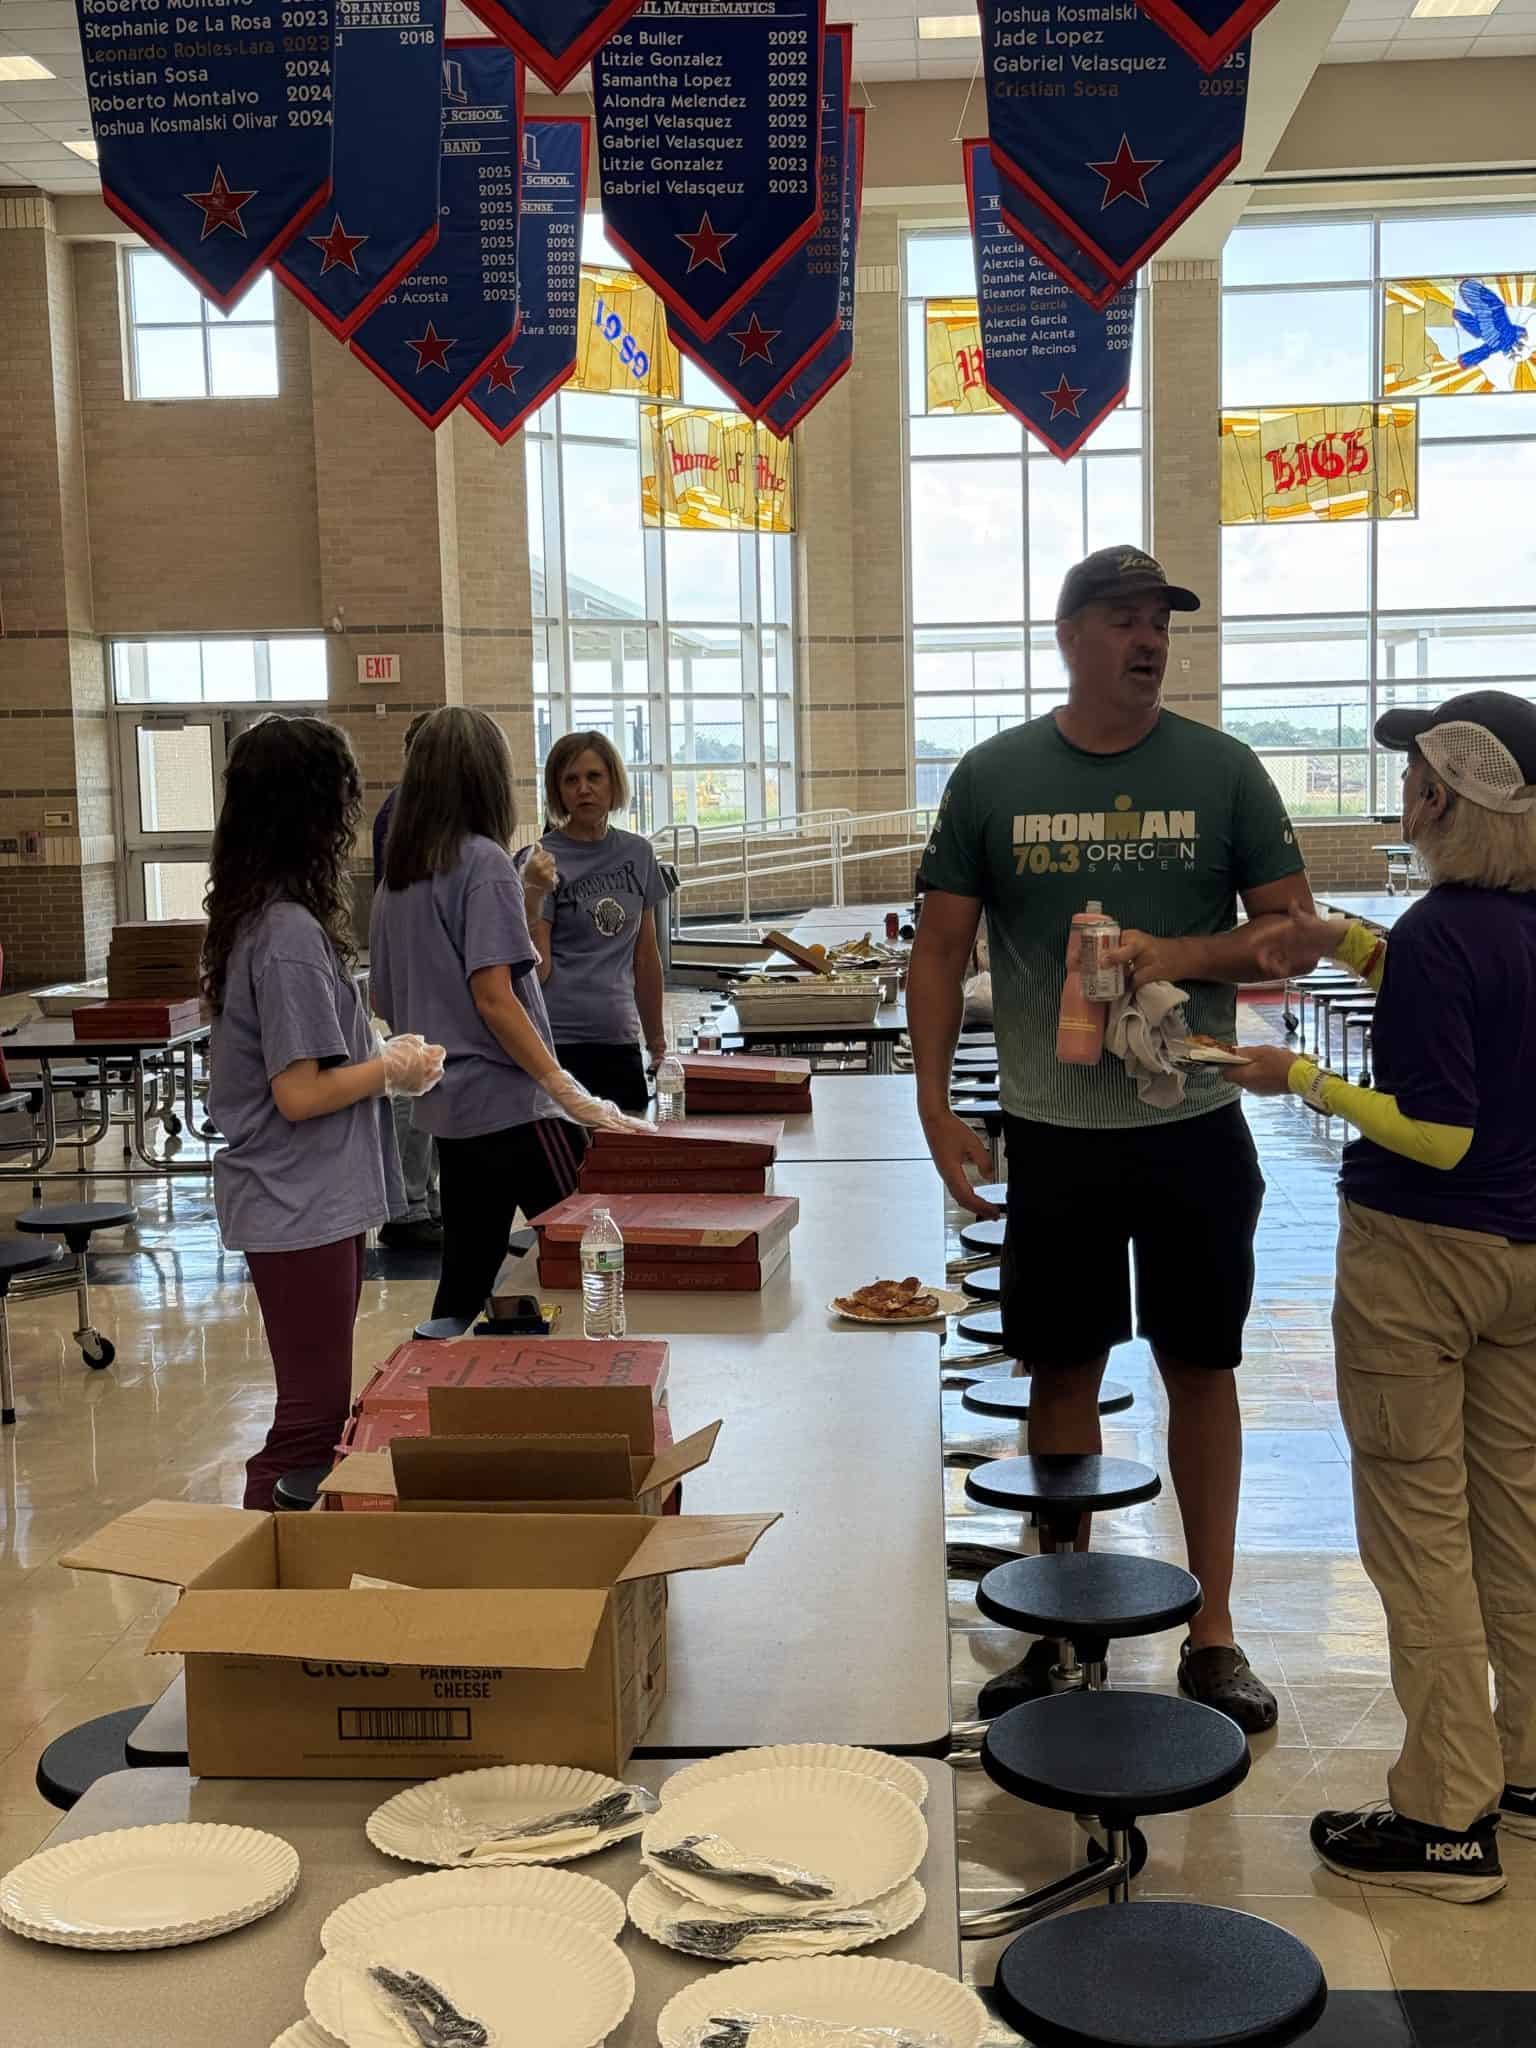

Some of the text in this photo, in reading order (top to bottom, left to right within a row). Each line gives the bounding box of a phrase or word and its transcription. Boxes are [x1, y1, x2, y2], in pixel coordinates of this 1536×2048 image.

[663, 1, 775, 14] MATHEMATICS
[994, 7, 1050, 24] Joshua
[1057, 4, 1137, 21] Kosmalski
[84, 18, 169, 40] Stephanie
[176, 18, 198, 33] De
[205, 17, 224, 32] La
[231, 15, 272, 30] Rosa
[281, 10, 328, 27] 2023
[344, 13, 420, 25] SPEAKING
[400, 30, 434, 45] 2018
[639, 31, 684, 46] Buller
[768, 31, 808, 45] 2022
[994, 29, 1105, 48] Jade Lopez
[87, 44, 168, 64] Leonardo
[282, 35, 330, 52] 2023
[601, 52, 808, 67] Litzie Gonzalez 2022
[993, 52, 1246, 75] Gabriel Velasquez 25
[88, 60, 331, 88] Cristian Sosa 2024
[602, 72, 808, 90] Samantha Lopez 2022
[995, 79, 1065, 98] Cristian
[1074, 79, 1119, 98] Sosa
[91, 84, 332, 113] Roberto Montalvo 2024
[603, 94, 666, 108] Alondra
[671, 94, 747, 108] Melendez
[768, 93, 808, 108] 2022
[150, 115, 226, 134] Kosmalski
[232, 113, 278, 130] Olivar
[287, 110, 333, 127] 2024
[451, 110, 503, 121] SCHOOL
[603, 114, 808, 131] Angel Velasquez 2022
[443, 142, 481, 153] BAND
[603, 135, 808, 151] Gabriel Velasquez 2022
[603, 157, 808, 172] Litzie Gonzalez 2023
[478, 166, 512, 179] 2025
[526, 175, 570, 185] SCHOOL
[479, 184, 512, 196] 2025
[604, 180, 660, 195] Gabriel
[768, 180, 808, 194] 2023
[479, 202, 513, 214] 2025
[480, 219, 514, 231] 2025
[480, 236, 514, 248] 2025
[481, 254, 515, 266] 2025
[482, 272, 516, 284] 2025
[402, 293, 449, 304] Acosta
[482, 289, 516, 301] 2025
[983, 287, 1025, 300] Eleanor
[985, 339, 1132, 360] Eleanor Recinos 202
[366, 656, 392, 678] EXIT
[1012, 810, 1196, 844] IRONMAN
[1012, 844, 1081, 876] 70.3
[1088, 861, 1195, 873] SALEM
[420, 1667, 502, 1680] PARMESAN
[433, 1682, 491, 1698] CHEESE
[1426, 1841, 1483, 1861] HOKA
